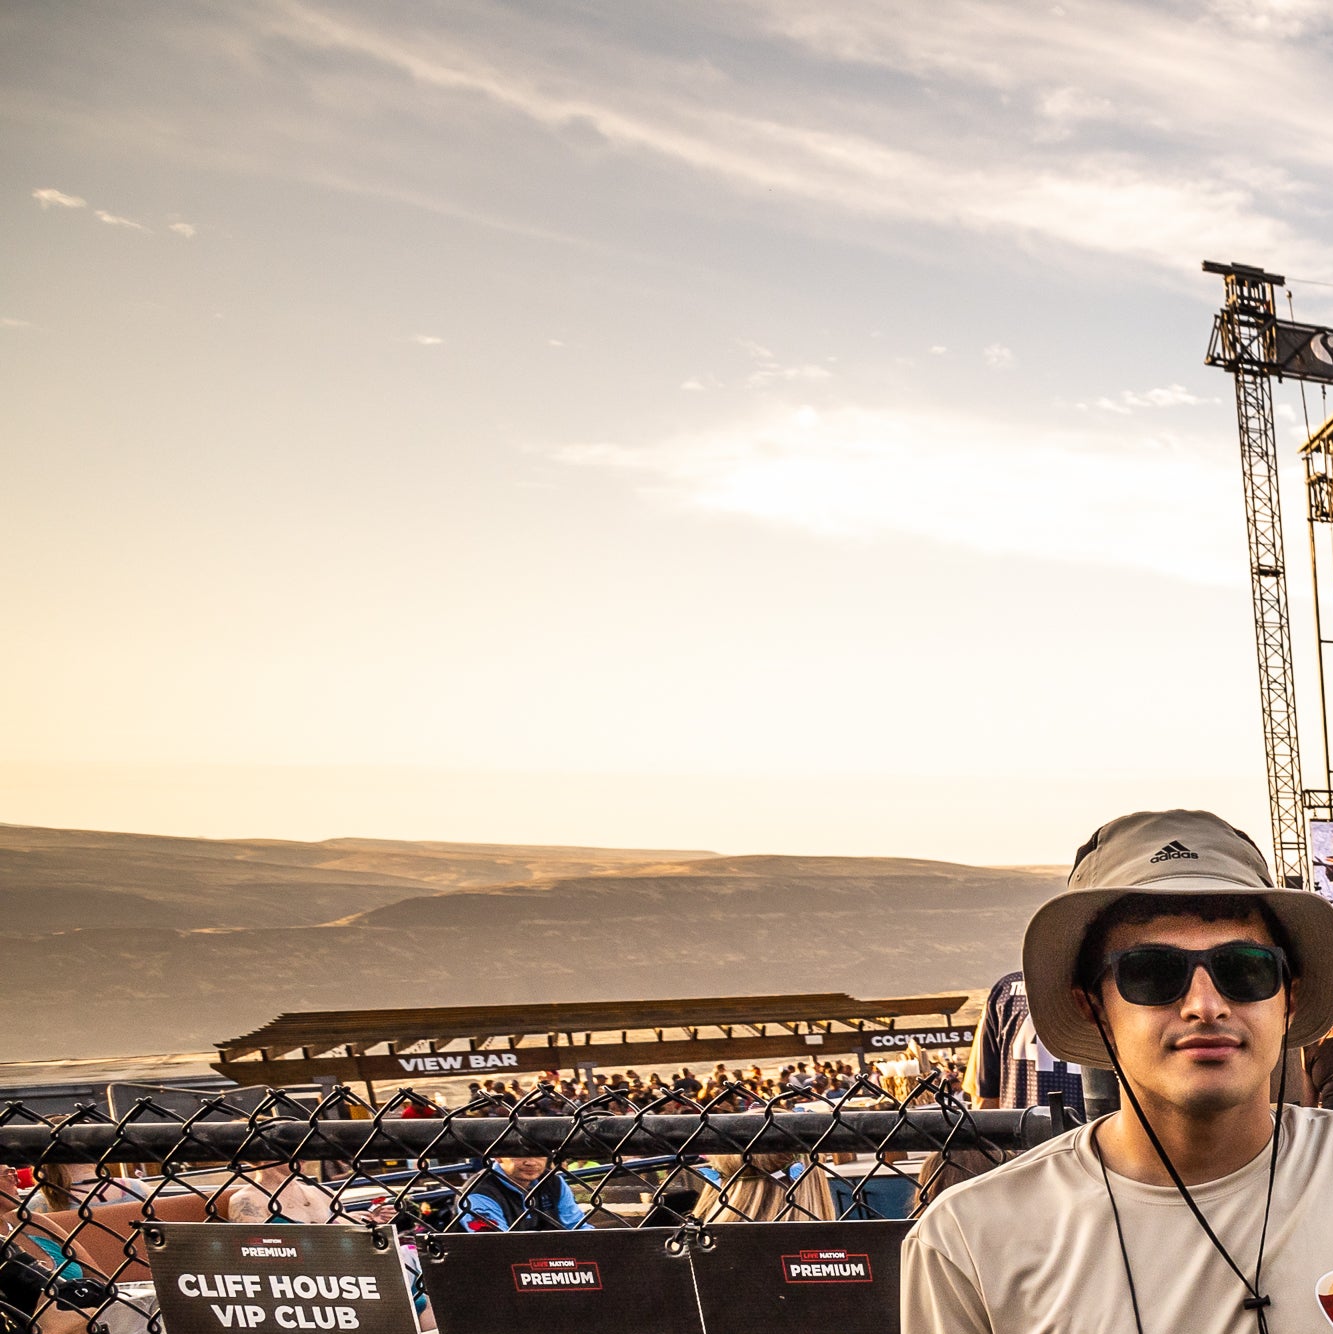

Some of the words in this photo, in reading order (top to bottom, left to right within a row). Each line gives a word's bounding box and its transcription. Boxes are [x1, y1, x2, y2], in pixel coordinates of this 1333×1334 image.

[1150, 850, 1199, 864] adidas
[871, 1031, 961, 1047] COCKTAILS
[963, 1031, 973, 1042] &
[399, 1056, 463, 1072] VIEW
[468, 1053, 518, 1068] BAR
[241, 1247, 297, 1258] PREMIUM
[819, 1251, 845, 1259] NATION
[549, 1260, 575, 1268] NATION
[790, 1263, 865, 1277] PREMIUM
[520, 1271, 594, 1286] PREMIUM
[177, 1273, 262, 1298] CLIFF
[268, 1275, 381, 1300] HOUSE
[210, 1304, 266, 1329] VIP
[274, 1305, 360, 1330] CLUB
